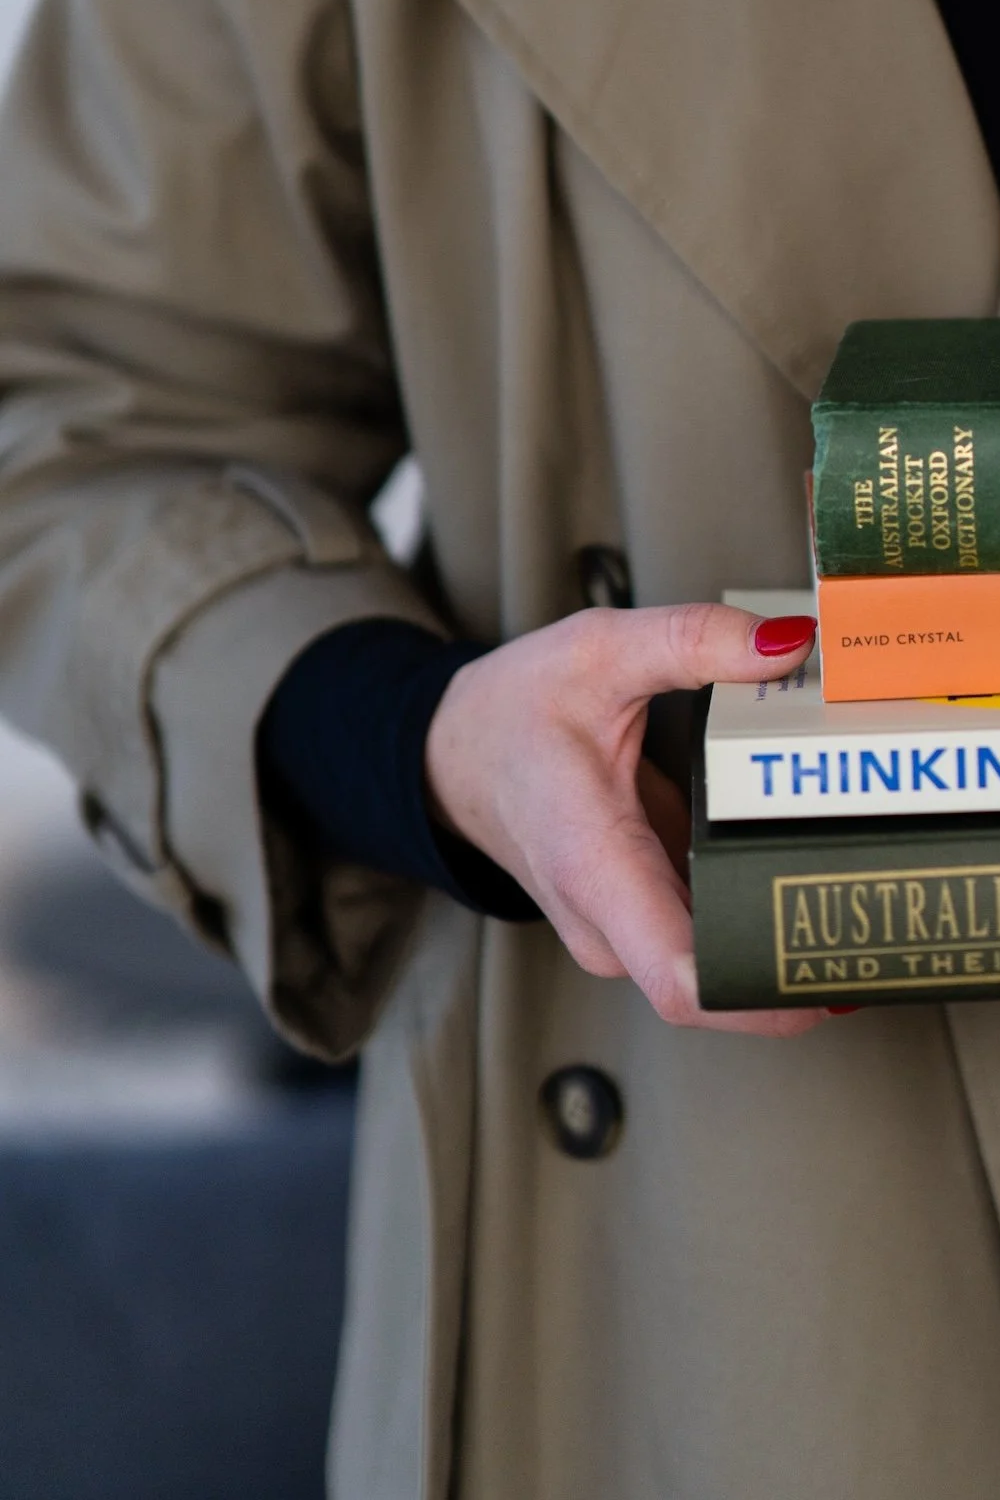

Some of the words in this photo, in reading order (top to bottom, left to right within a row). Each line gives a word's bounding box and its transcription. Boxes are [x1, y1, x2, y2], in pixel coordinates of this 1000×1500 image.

[854, 479, 874, 529] THE
[879, 426, 904, 568] AUSTRALIAN
[904, 454, 926, 548] POCKET
[929, 451, 951, 550] OXFORD
[953, 426, 979, 568] DICTIONARY
[841, 635, 890, 648] DAVID
[896, 630, 964, 645] CRYSTAL
[794, 957, 881, 982] AND
